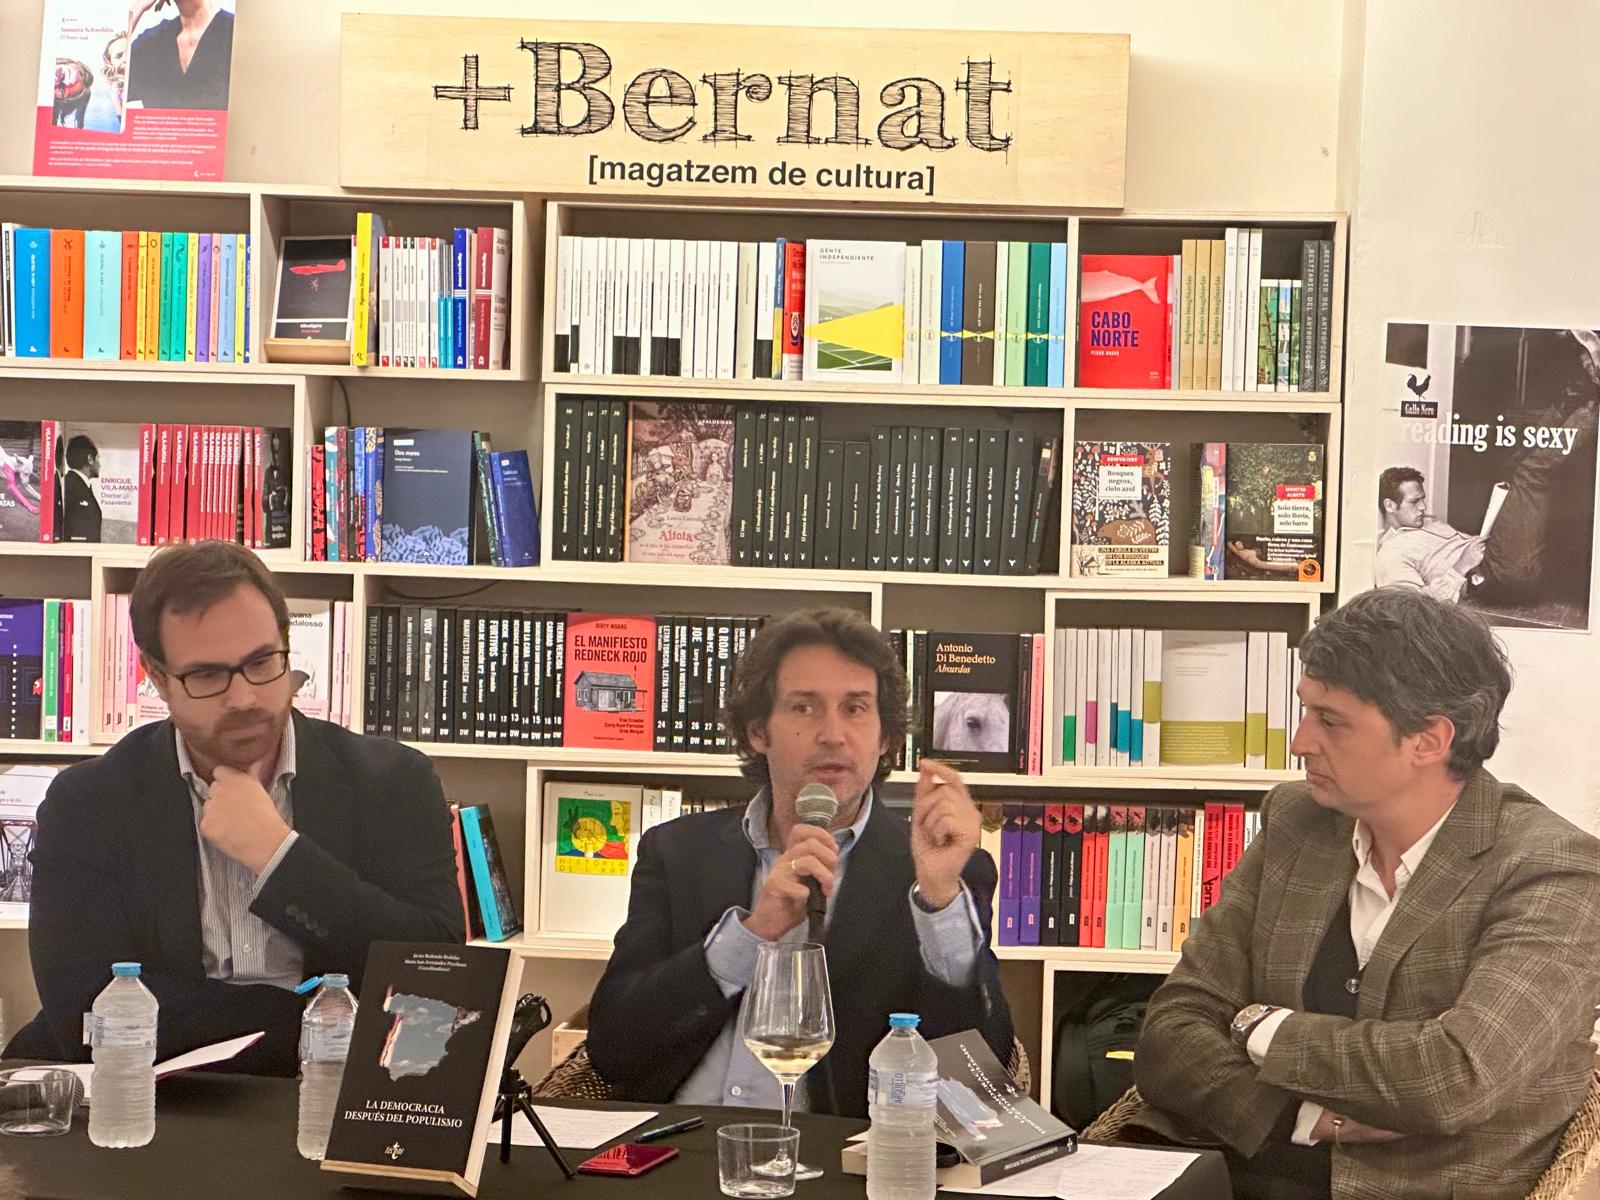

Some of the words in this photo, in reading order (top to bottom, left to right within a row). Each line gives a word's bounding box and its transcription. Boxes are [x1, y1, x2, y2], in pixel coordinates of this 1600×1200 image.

[588, 154, 757, 187] [magatzem
[767, 161, 807, 186] de
[816, 163, 935, 195] cultura]
[1307, 249, 1315, 293] BESTIARIO
[1322, 249, 1330, 293] BESTIARIO
[1321, 297, 1329, 312] DEL
[1091, 311, 1131, 329] CABO
[1090, 329, 1139, 347] NORTE
[1404, 403, 1420, 416] Gallo
[1420, 403, 1435, 416] Nero
[1398, 411, 1490, 452] reading
[1495, 415, 1516, 447] is
[1523, 425, 1578, 456] sexy
[1107, 470, 1134, 478] Bosques
[368, 615, 378, 645] TRABAJO
[423, 618, 433, 635] VOLT
[501, 620, 509, 639] COCHE
[523, 621, 531, 633] DAR
[556, 622, 564, 643] TIERRA
[489, 620, 499, 657] FURTIVOS
[523, 634, 530, 642] LA
[575, 635, 586, 647] EL
[588, 636, 648, 649] MANIFIESTO
[692, 626, 702, 643] JOE
[718, 635, 729, 659] ROAD
[936, 643, 973, 653] Antonio
[368, 645, 377, 665] SUCIO
[555, 643, 563, 670] VENCIDA
[574, 649, 621, 662] REDNECK
[622, 650, 647, 663] ROJO
[661, 643, 670, 669] TORCIDA,
[936, 653, 947, 663] Di
[948, 654, 996, 665] Benedetto
[462, 655, 470, 683] REDNECK
[934, 664, 971, 674] Absurdos
[661, 688, 669, 713] TORCIDA
[476, 712, 484, 721] 10
[489, 713, 496, 722] 11
[511, 713, 519, 722] 13
[522, 717, 529, 725] 14
[532, 715, 541, 725] 15
[657, 720, 666, 729] 24
[674, 720, 683, 729] 25
[691, 721, 700, 730] 26
[704, 722, 712, 731] 27
[559, 858, 624, 867] HISTORIA
[966, 1063, 1013, 1115] DEMOCRACIA
[365, 1099, 378, 1109] LA
[380, 1100, 445, 1114] DEMOCRACIA
[344, 1110, 385, 1122] DESPUÉS
[385, 1113, 404, 1123] DEL
[405, 1114, 463, 1128] POPULISMO
